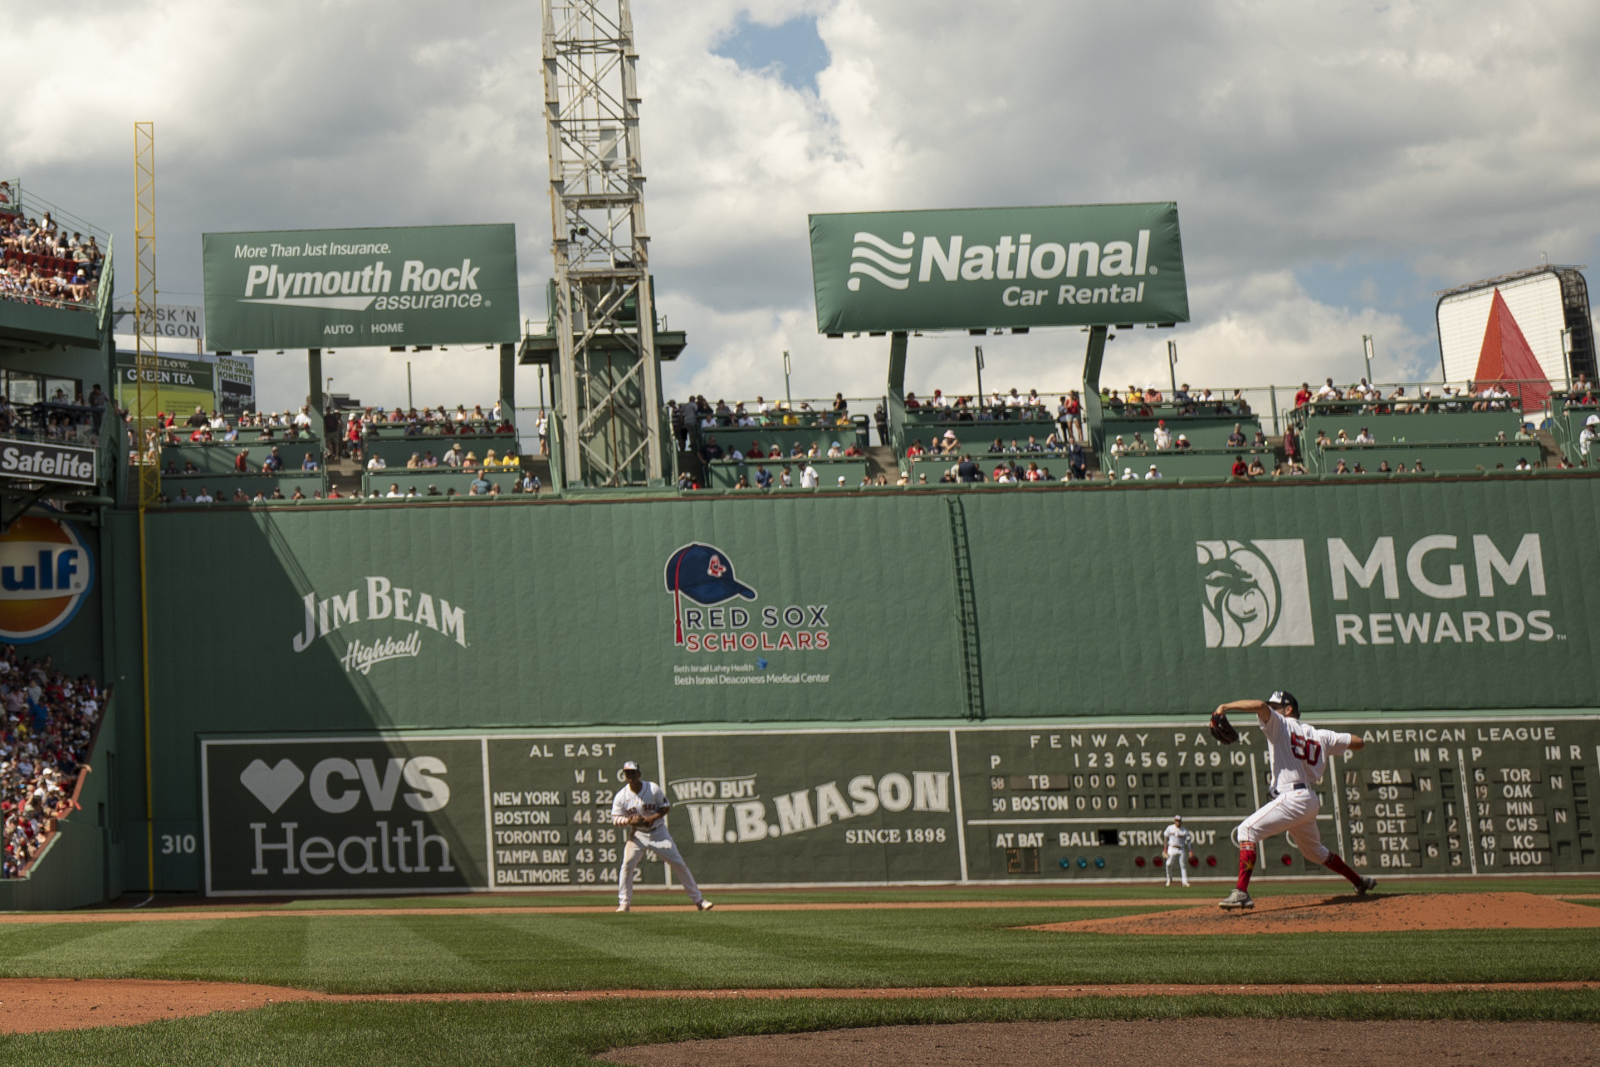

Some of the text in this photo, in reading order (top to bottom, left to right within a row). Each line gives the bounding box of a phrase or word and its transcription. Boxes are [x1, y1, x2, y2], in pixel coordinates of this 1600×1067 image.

[234, 242, 391, 259] More Than Just Insurance.
[918, 229, 1150, 283] National
[245, 259, 481, 299] Plymouth Rock
[375, 292, 482, 311] assurance
[1002, 282, 1145, 307] Car Rental
[133, 321, 200, 337] FLAGON
[324, 323, 404, 335] AUTO HOME
[127, 369, 195, 385] GREEN TEA
[2, 447, 92, 479] Safelite
[1326, 533, 1547, 601] MGM
[292, 576, 468, 653] JIM BEAM
[684, 605, 830, 630] RED SOX
[1336, 609, 1554, 645] REWARDS
[685, 631, 830, 653] SCHOLARS
[340, 630, 422, 675] Highball
[674, 663, 754, 674] Beth Health
[674, 673, 830, 685] Beth Israel Deaconess Medical Center
[1174, 731, 1251, 747] PAK
[1362, 727, 1556, 743] AMERICAN LEAGUE
[529, 743, 616, 757] AL EAST
[1291, 732, 1320, 767] 50
[1414, 747, 1450, 763] IN R
[1472, 745, 1582, 761] P IN R
[990, 751, 1246, 769] P 10
[574, 769, 608, 783] W L
[1028, 775, 1050, 789] TB
[1372, 769, 1401, 784] SEA
[1500, 769, 1531, 782] TOR
[308, 755, 450, 813] CVS
[672, 779, 756, 801] WHO BUT
[1502, 785, 1533, 798] OAK
[494, 790, 613, 806] NEW YORK 58 22
[1378, 786, 1398, 799] SD
[992, 795, 1068, 812] 50 BOSTON
[1374, 803, 1406, 817] CLE
[1506, 801, 1534, 815] MIN
[494, 809, 612, 825] BOSTON 44 35
[1506, 817, 1538, 831] CWS
[1376, 820, 1407, 833] DET
[161, 834, 196, 853] 310
[495, 829, 616, 845] TORONTO 44 36
[845, 827, 946, 844] SINCE 1898
[996, 829, 1216, 848] AT BAT BALL STRIK OUT
[1512, 835, 1535, 849] KC
[250, 820, 455, 875] Health
[1378, 837, 1409, 851] TEX
[496, 848, 618, 863] TAMPA BAY 43 36
[1380, 853, 1412, 867] BAL
[1509, 851, 1542, 865] HOU
[496, 867, 618, 883] BALTIMORE 36 44
